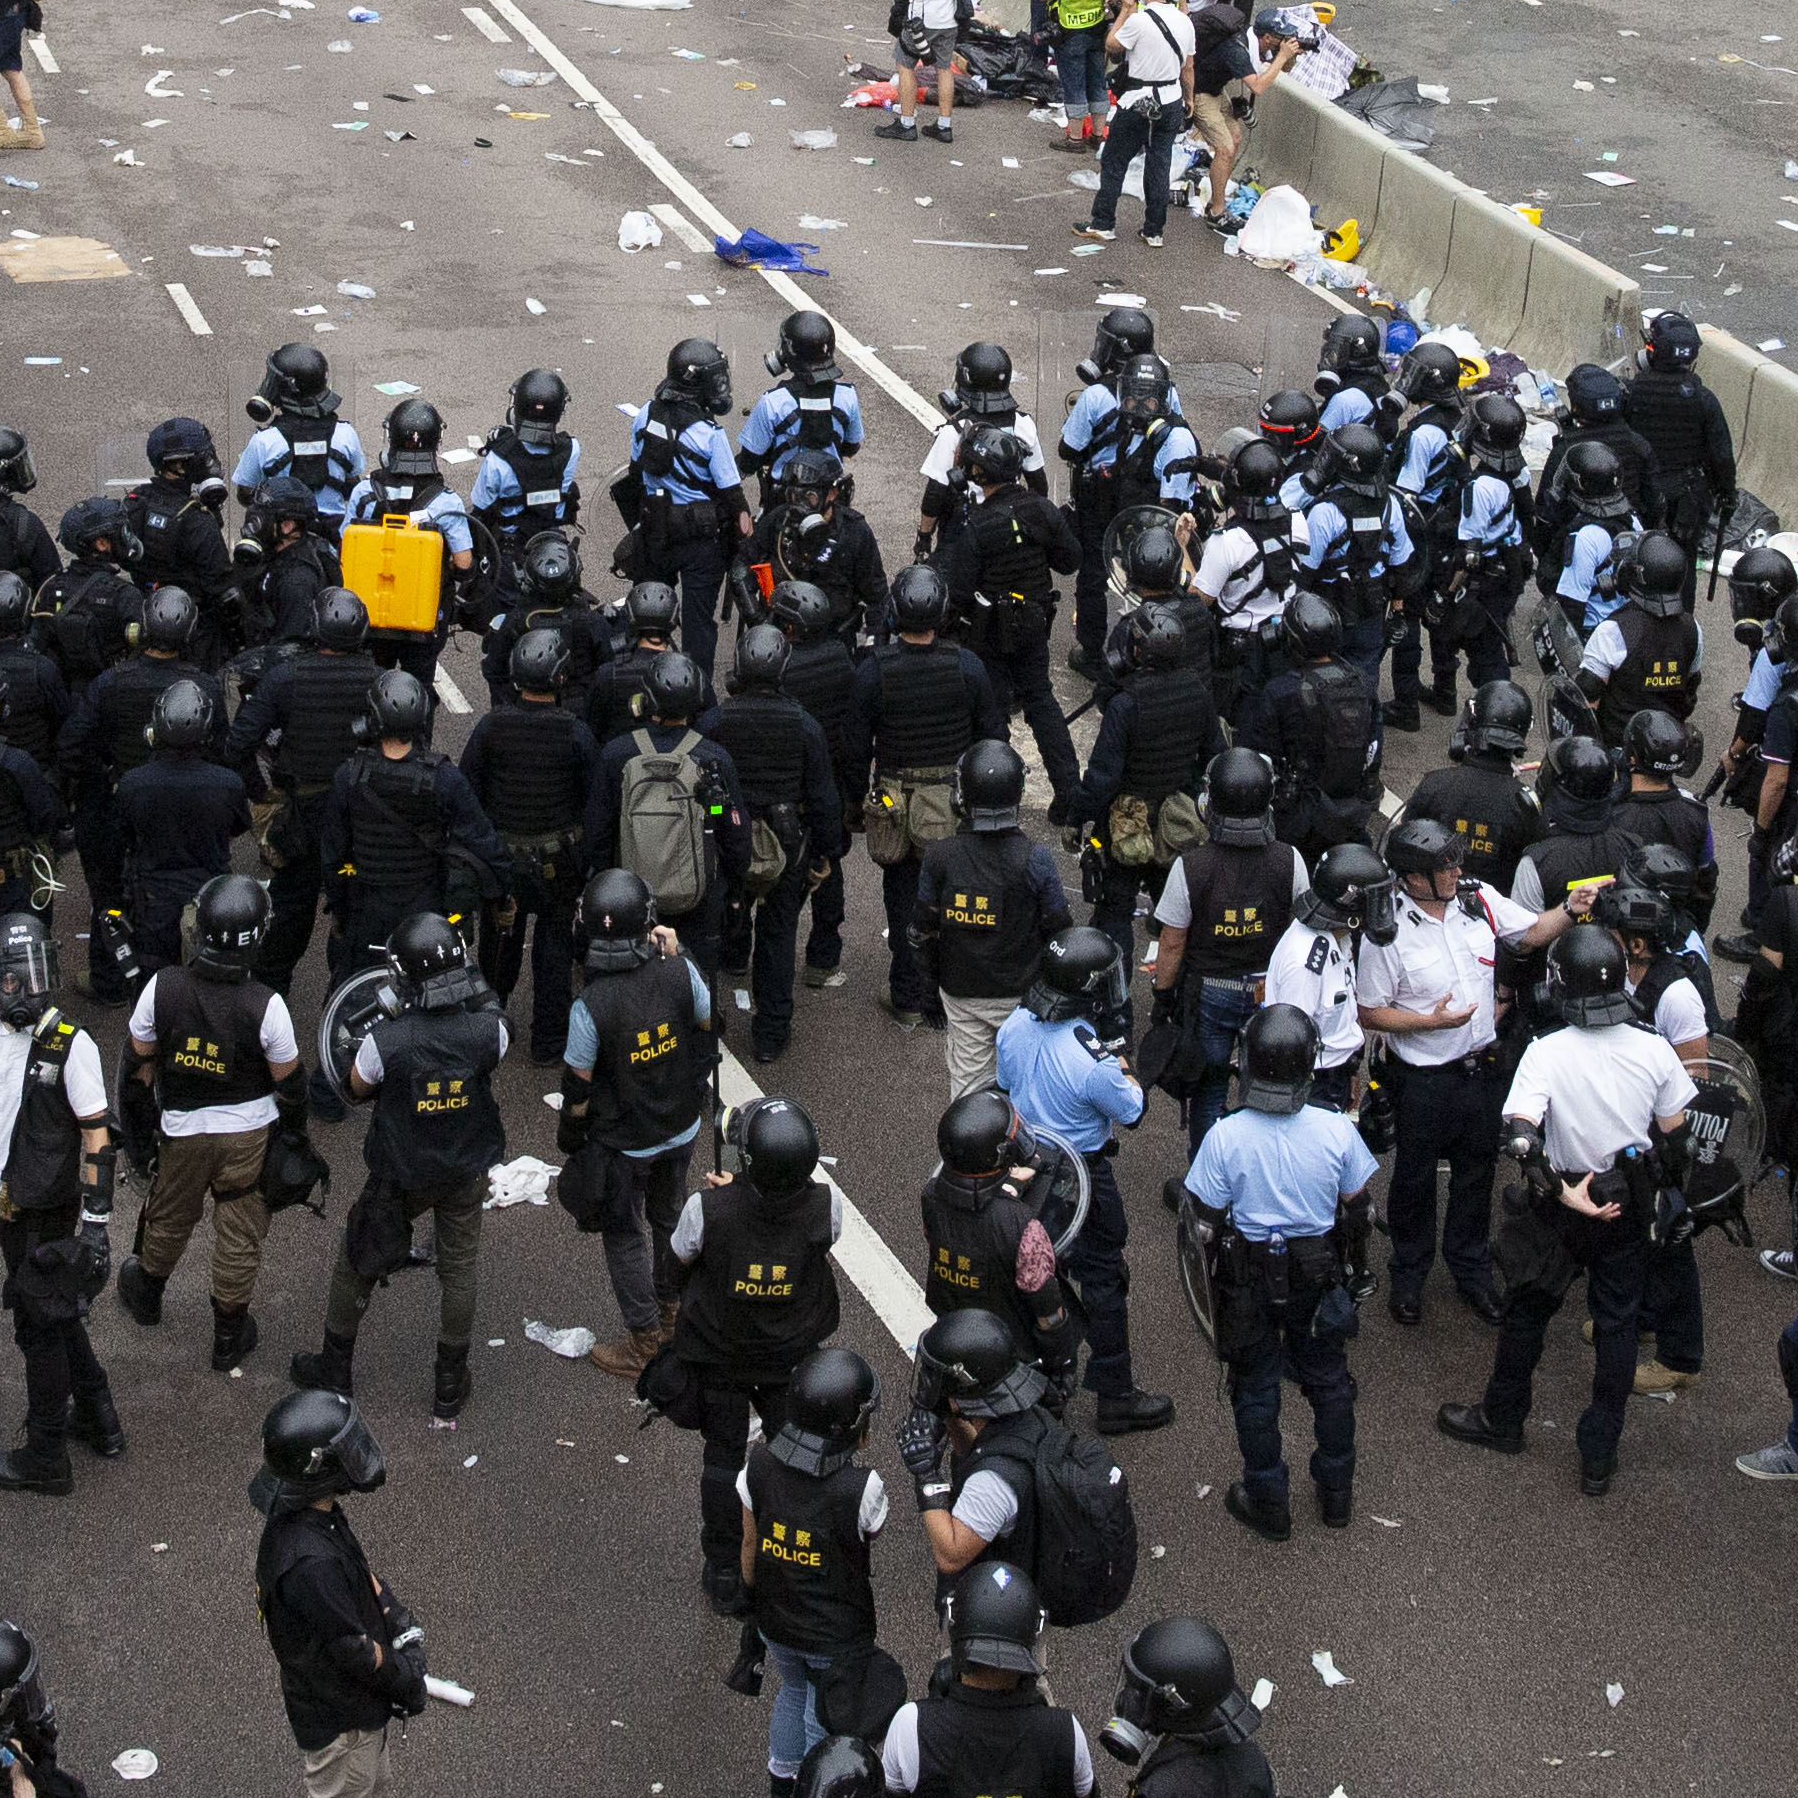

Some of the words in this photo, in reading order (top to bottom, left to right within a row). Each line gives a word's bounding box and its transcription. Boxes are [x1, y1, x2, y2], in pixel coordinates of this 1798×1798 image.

[1645, 675, 1682, 688] POLICE
[946, 908, 997, 926] POLICE
[238, 926, 259, 946] E1
[1214, 920, 1264, 938] POLICE
[8, 934, 33, 945] Police
[1049, 940, 1066, 957] Ord
[630, 1036, 678, 1064] POLICE
[175, 1051, 226, 1075] POLICE
[417, 1096, 470, 1113] POLICE
[934, 1261, 981, 1290] POLICE
[735, 1279, 794, 1297] POLICE
[773, 1521, 811, 1547] 警察
[762, 1537, 822, 1566] POLICE
